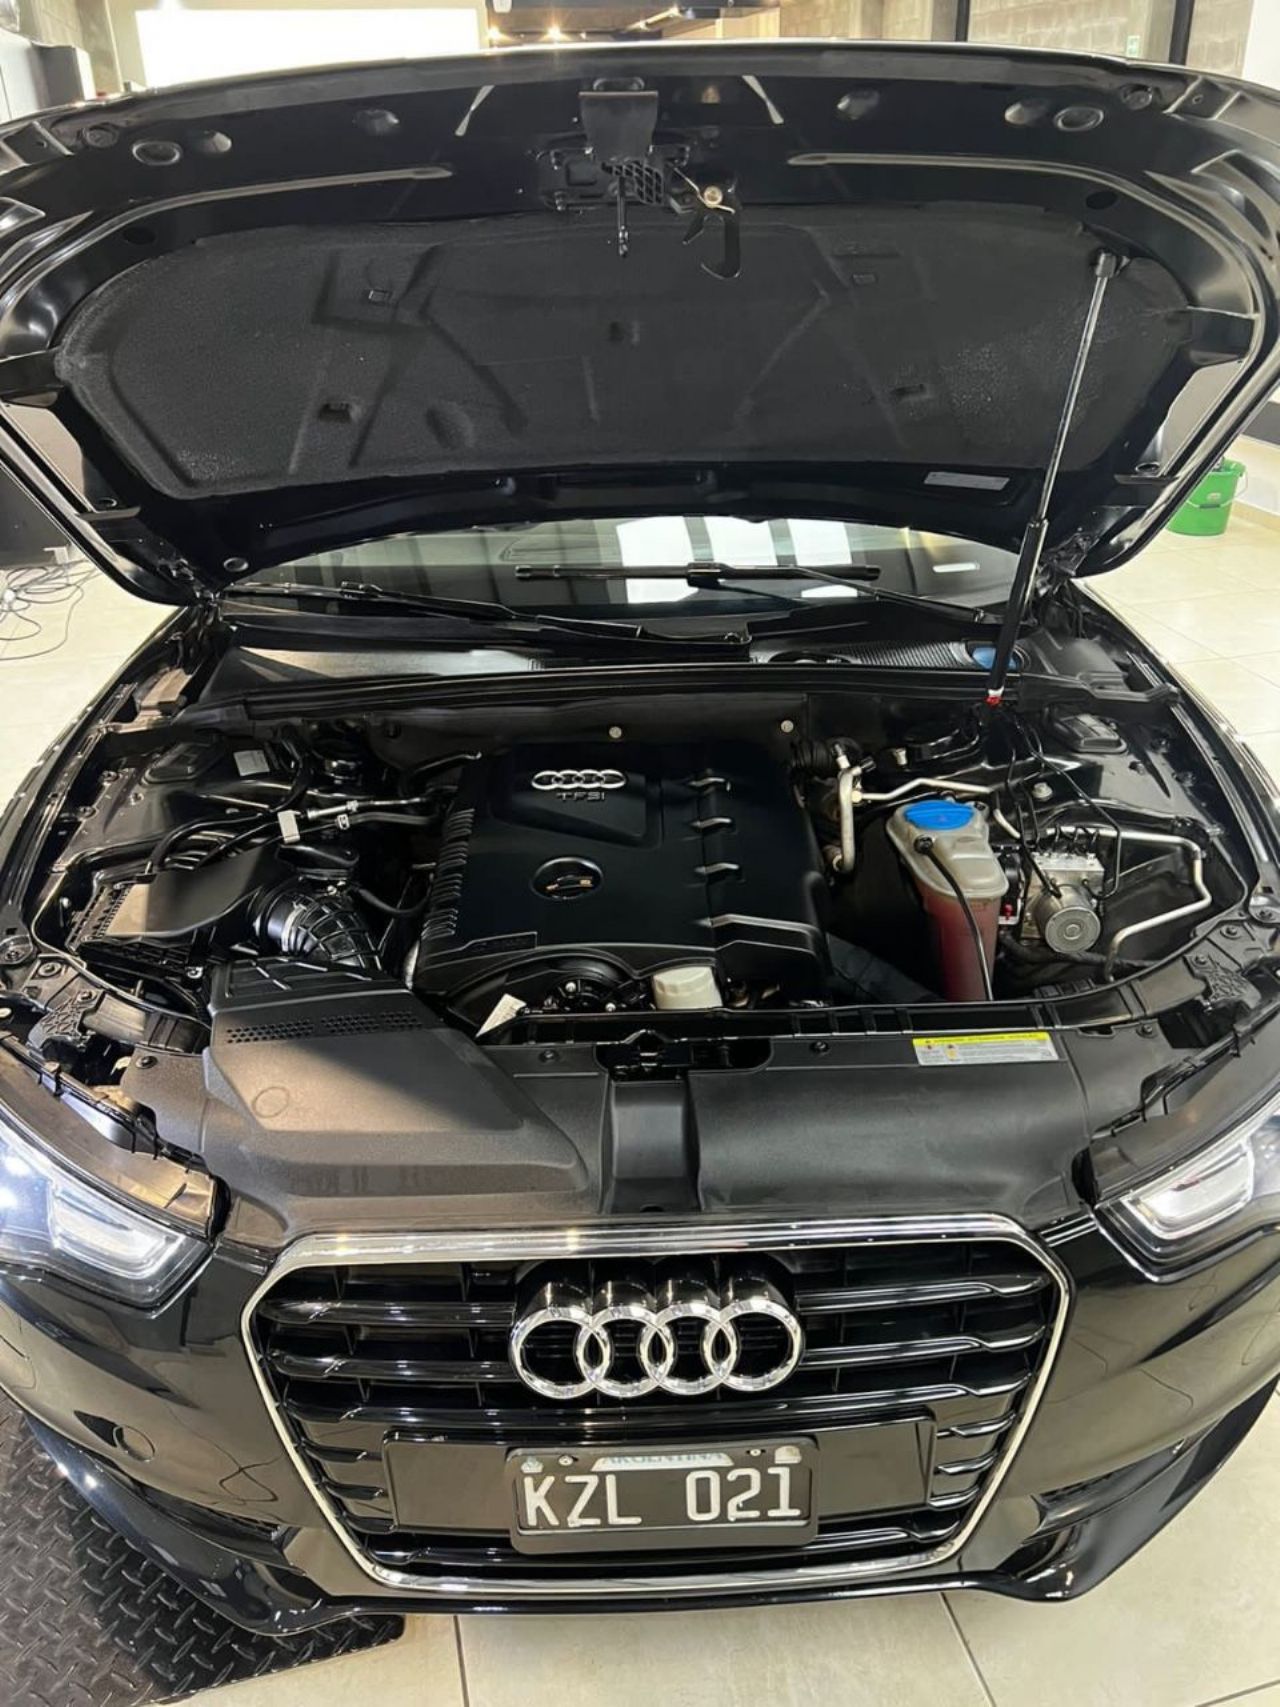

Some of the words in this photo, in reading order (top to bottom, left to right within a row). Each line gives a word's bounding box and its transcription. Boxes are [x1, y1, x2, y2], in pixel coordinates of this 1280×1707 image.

[556, 791, 605, 801] TFSI
[523, 1474, 642, 1527] KZL
[687, 1467, 801, 1522] 021
